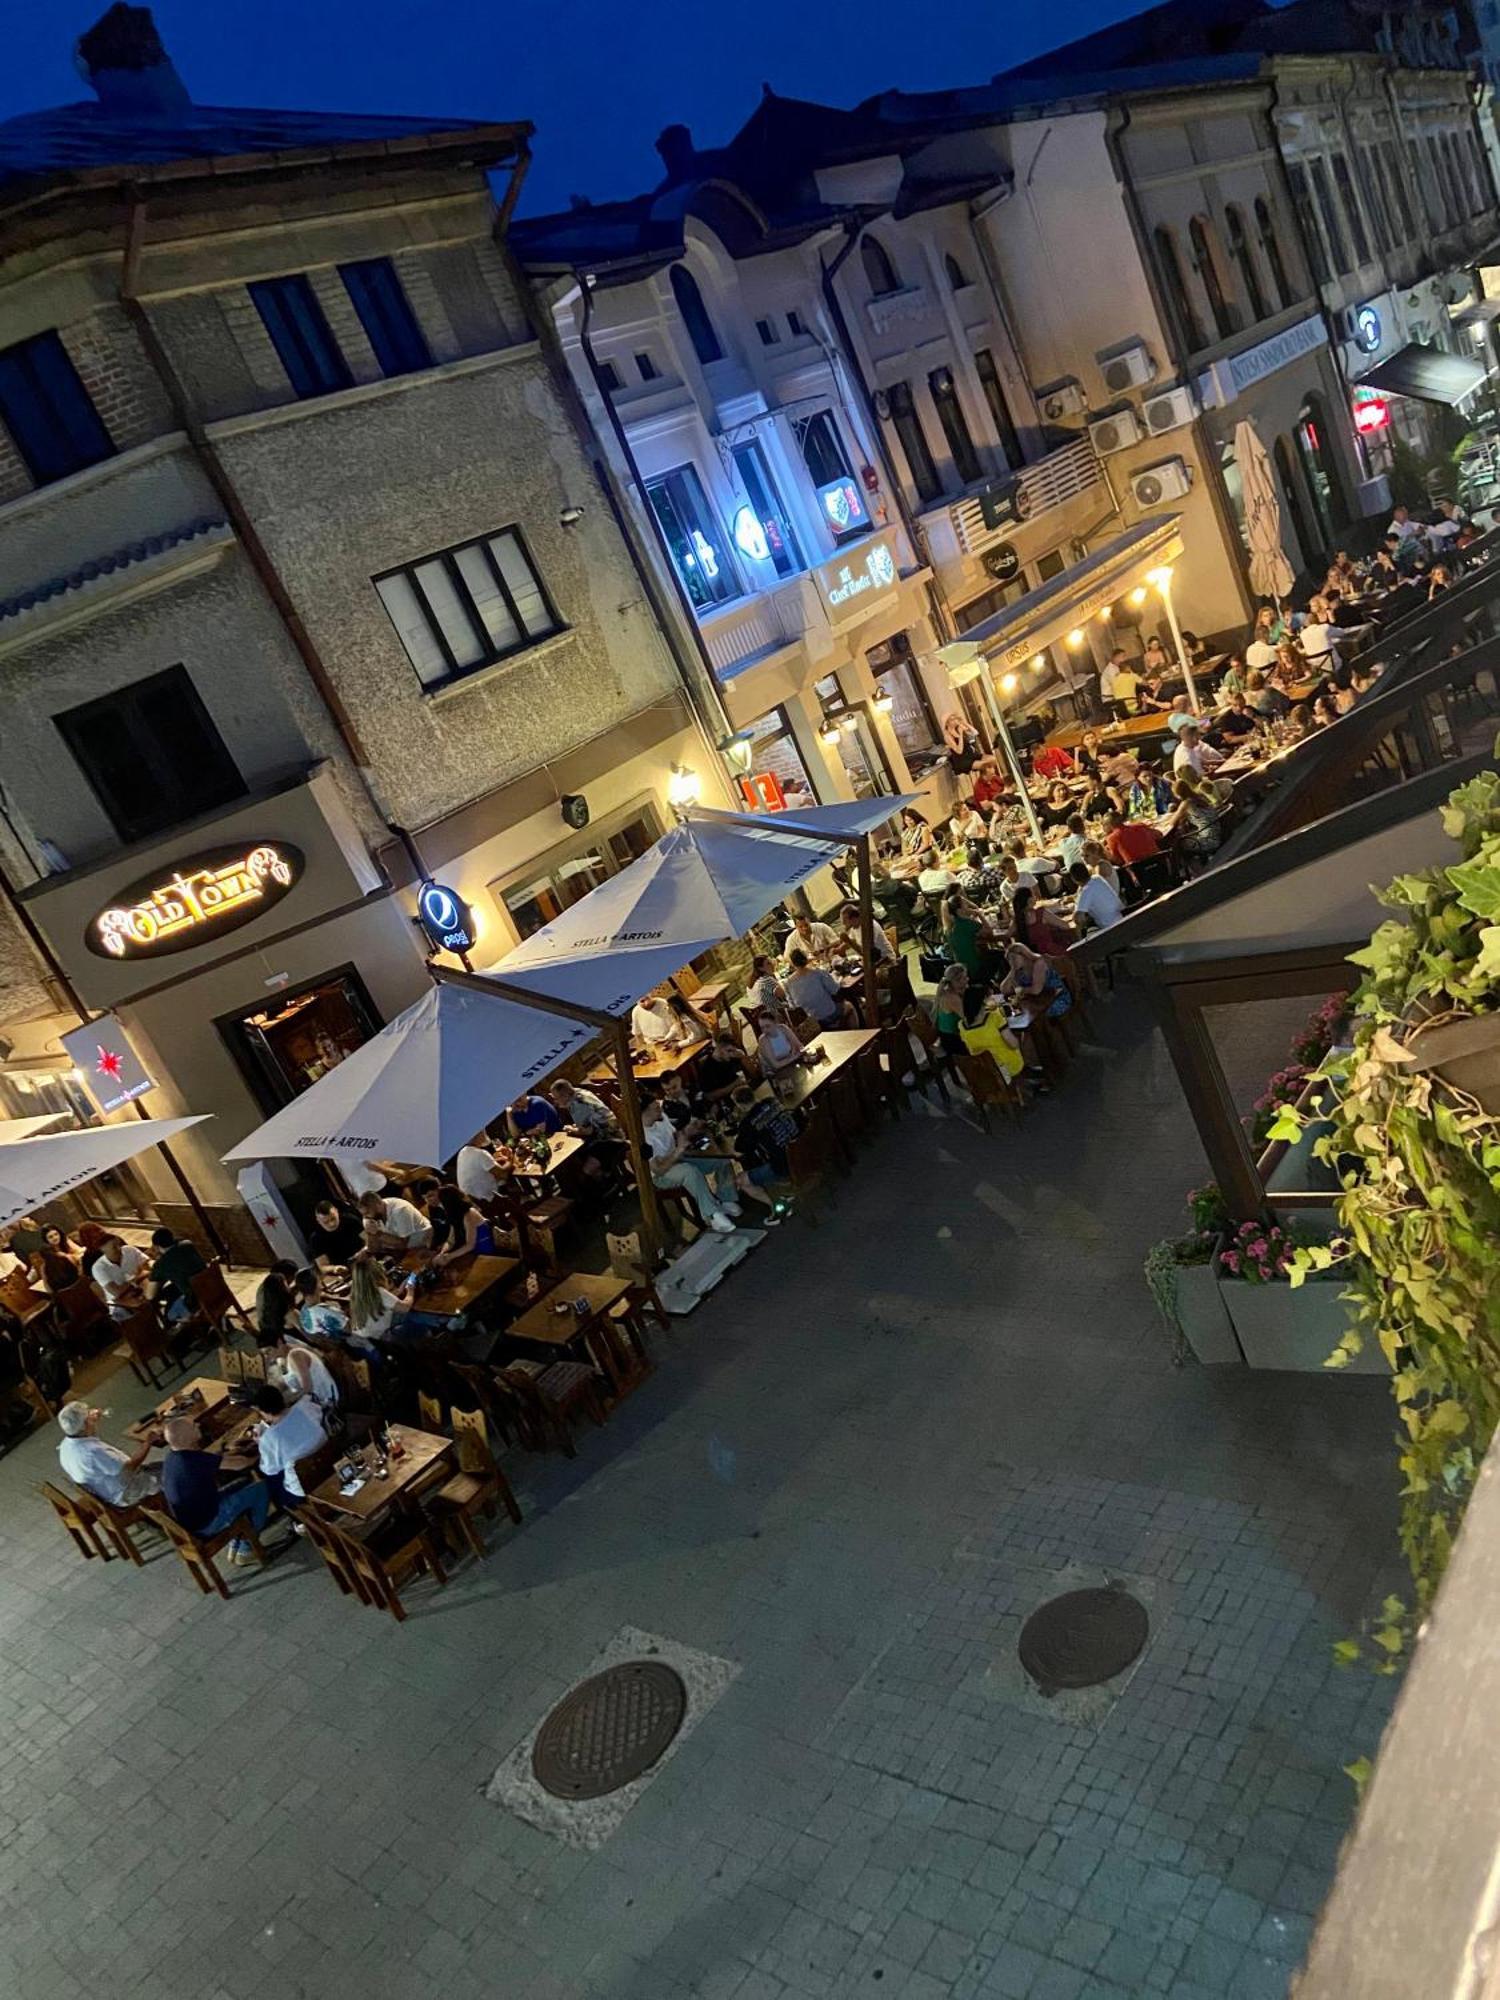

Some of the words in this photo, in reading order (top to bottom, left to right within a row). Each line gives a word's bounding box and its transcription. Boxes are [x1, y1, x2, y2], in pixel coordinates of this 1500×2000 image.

[443, 928, 469, 947] pepsi
[571, 936, 608, 948] STELLA
[618, 929, 664, 941] ARTOIS
[522, 1040, 575, 1079] STELLA
[294, 1136, 329, 1147] STELLA
[336, 1136, 379, 1149] ARTOIS
[42, 1167, 97, 1198] ARTOIS
